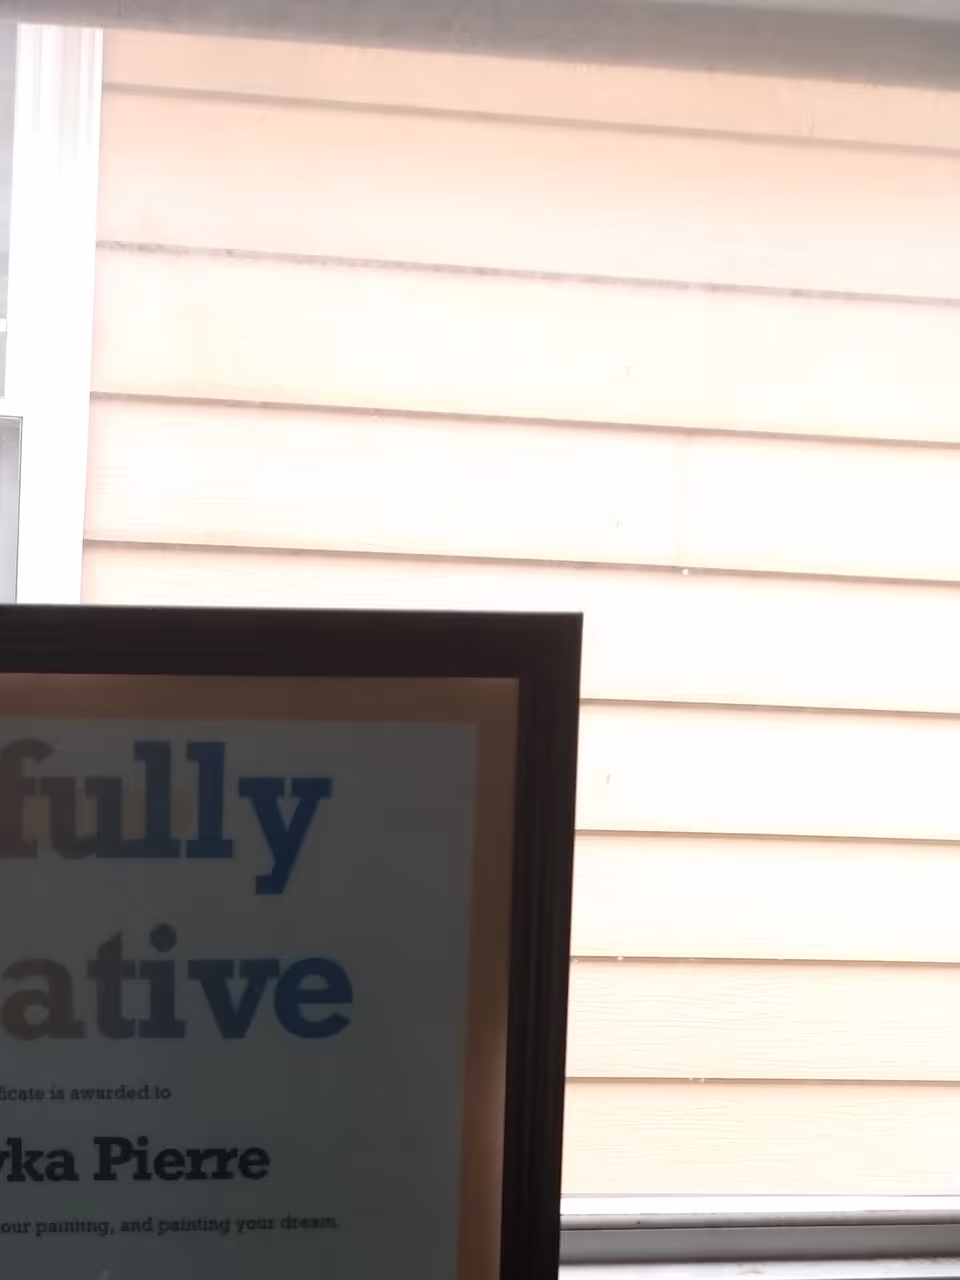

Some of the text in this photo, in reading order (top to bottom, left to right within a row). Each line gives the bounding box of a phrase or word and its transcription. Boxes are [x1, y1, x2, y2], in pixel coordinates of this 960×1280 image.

[50, 1086, 65, 1101] is
[70, 1084, 150, 1101] awarded
[154, 1085, 172, 1100] to
[93, 1135, 271, 1181] Pierre
[35, 1217, 114, 1238] painting,
[120, 1217, 153, 1233] and
[158, 1216, 230, 1236] painting
[236, 1217, 274, 1236] your
[279, 1213, 340, 1231] dream.
